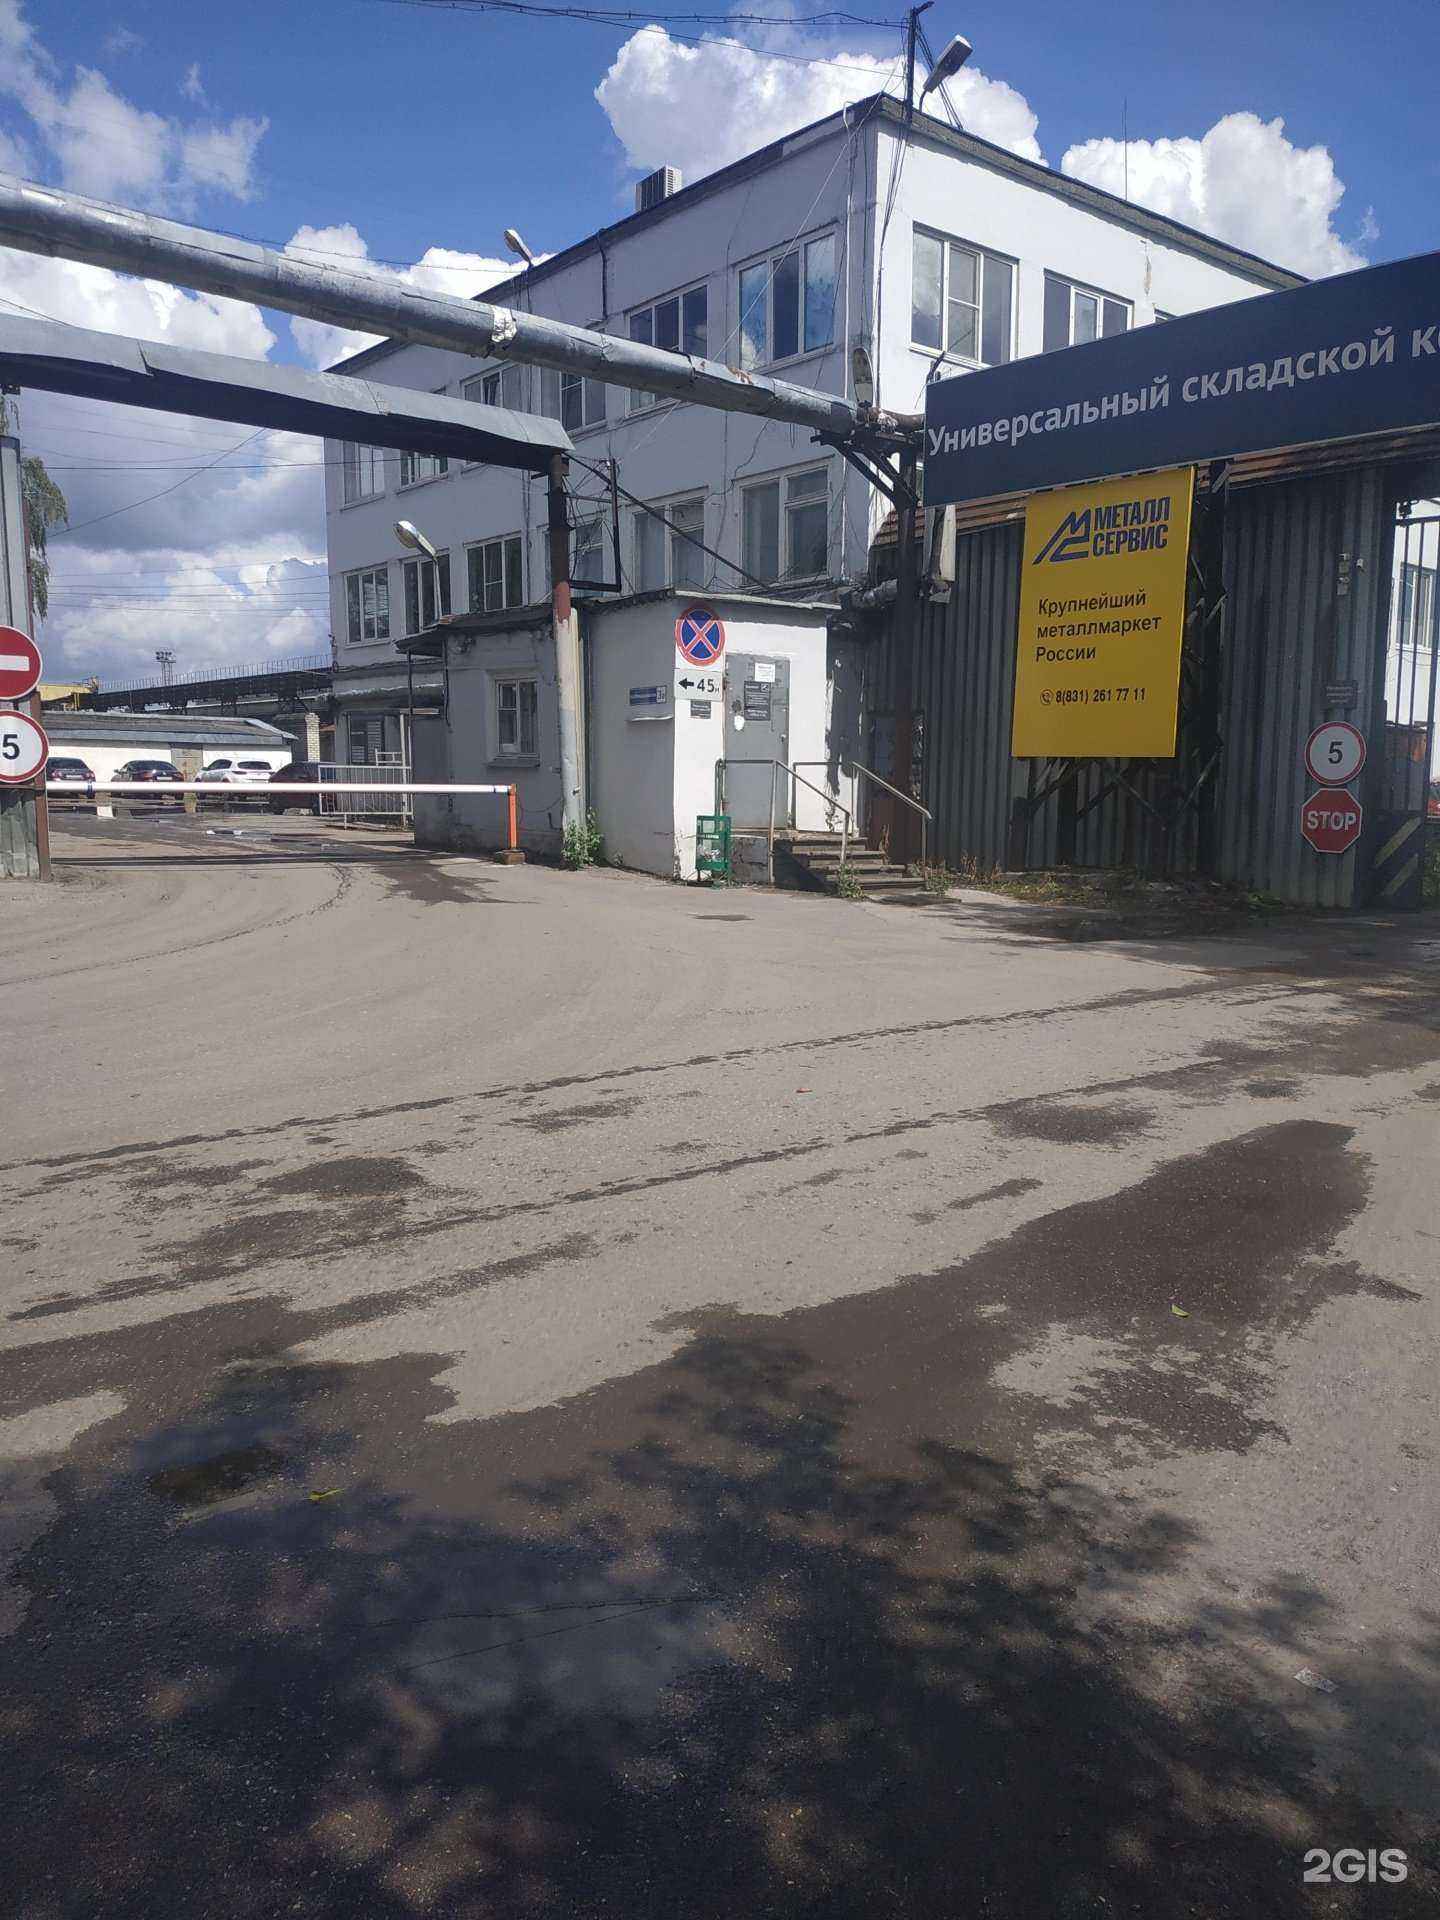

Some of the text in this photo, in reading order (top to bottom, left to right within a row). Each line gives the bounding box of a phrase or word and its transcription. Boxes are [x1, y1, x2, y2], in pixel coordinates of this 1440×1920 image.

[927, 326, 1440, 456] Универсальный складской к
[1093, 496, 1170, 531] МЕТАЛЛ
[1092, 524, 1169, 557] СЕРВИС
[1038, 588, 1147, 618] Крупнейший
[1036, 614, 1162, 640] металлмаркет
[1035, 646, 1097, 663] России
[1055, 688, 1146, 705] 8(831) 261 77 11
[1, 733, 20, 760] 5
[1327, 741, 1343, 764] 5
[1306, 810, 1357, 831] STOP
